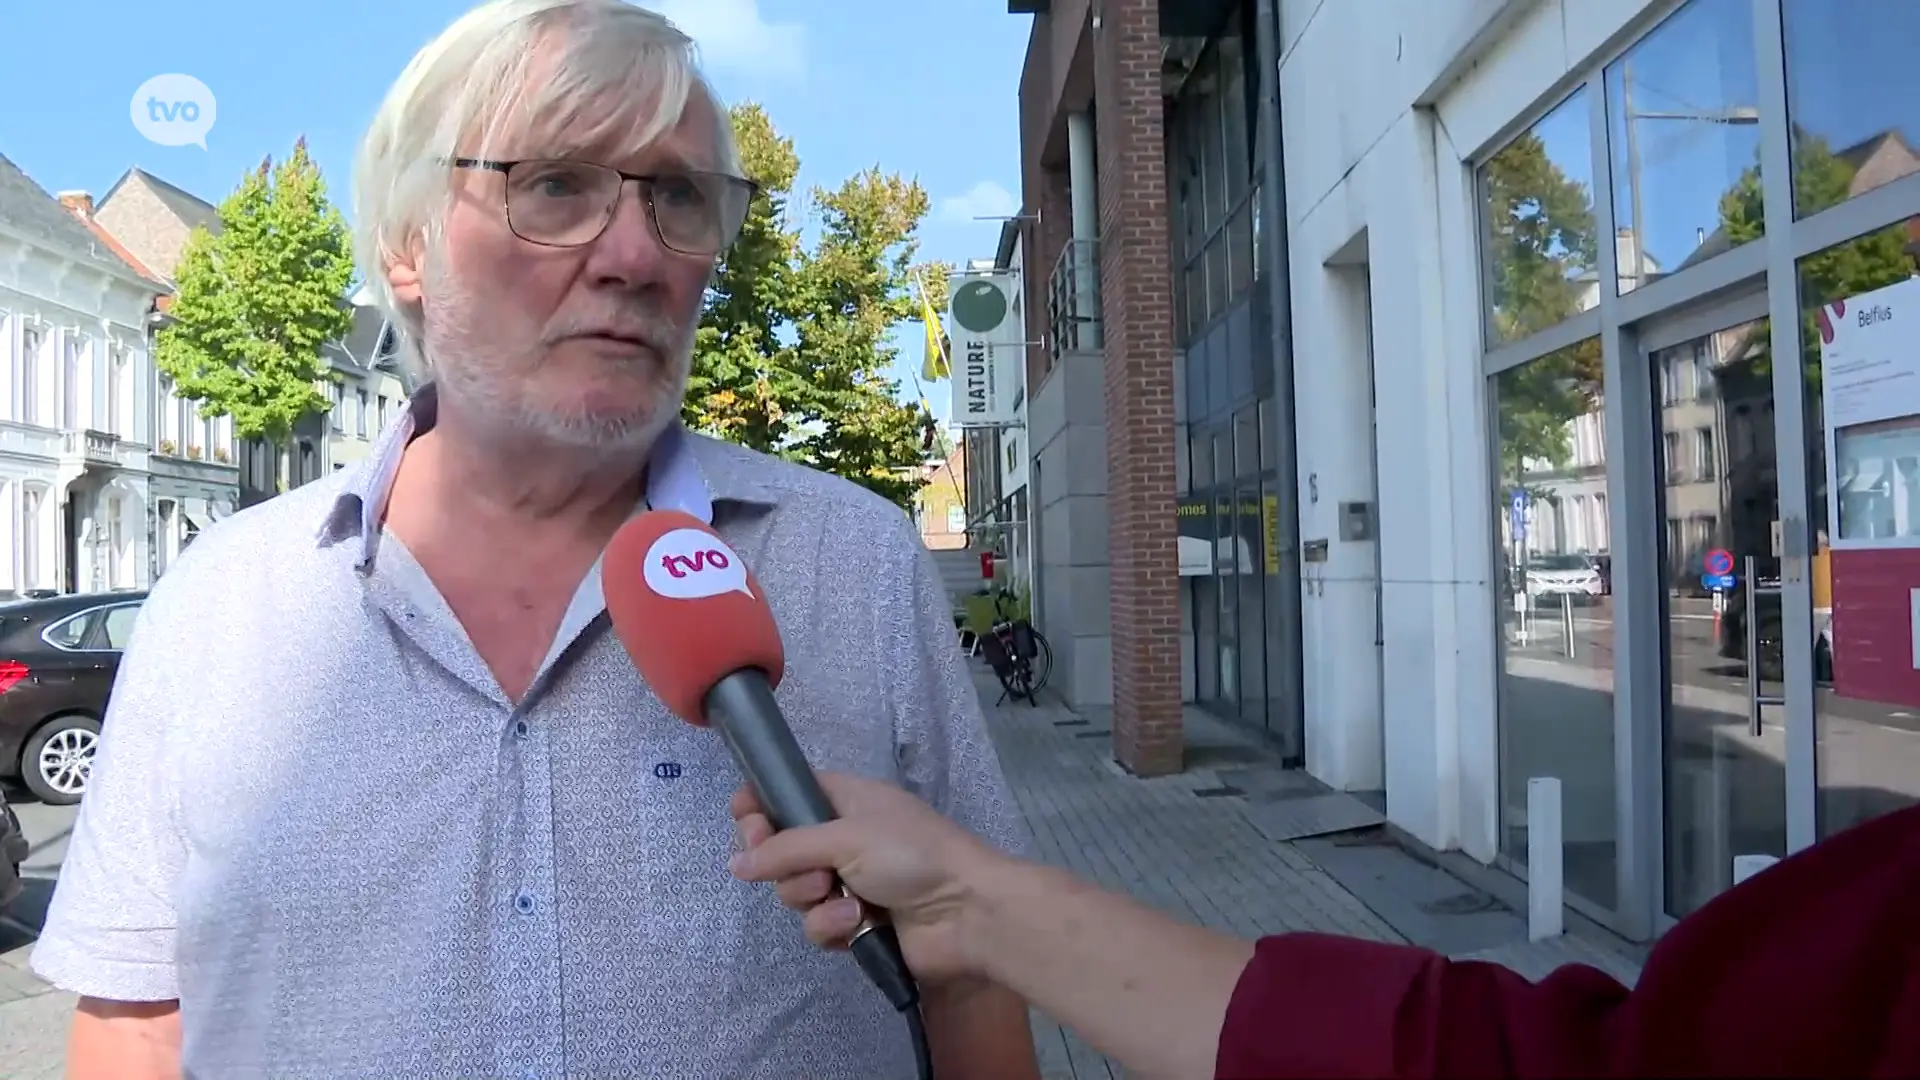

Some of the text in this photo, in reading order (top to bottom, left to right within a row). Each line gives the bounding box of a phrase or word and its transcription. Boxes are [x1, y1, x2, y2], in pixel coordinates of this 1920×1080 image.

[1858, 306, 1892, 328] Belfius
[967, 341, 986, 414] NATURE
[662, 549, 729, 578] tvo
